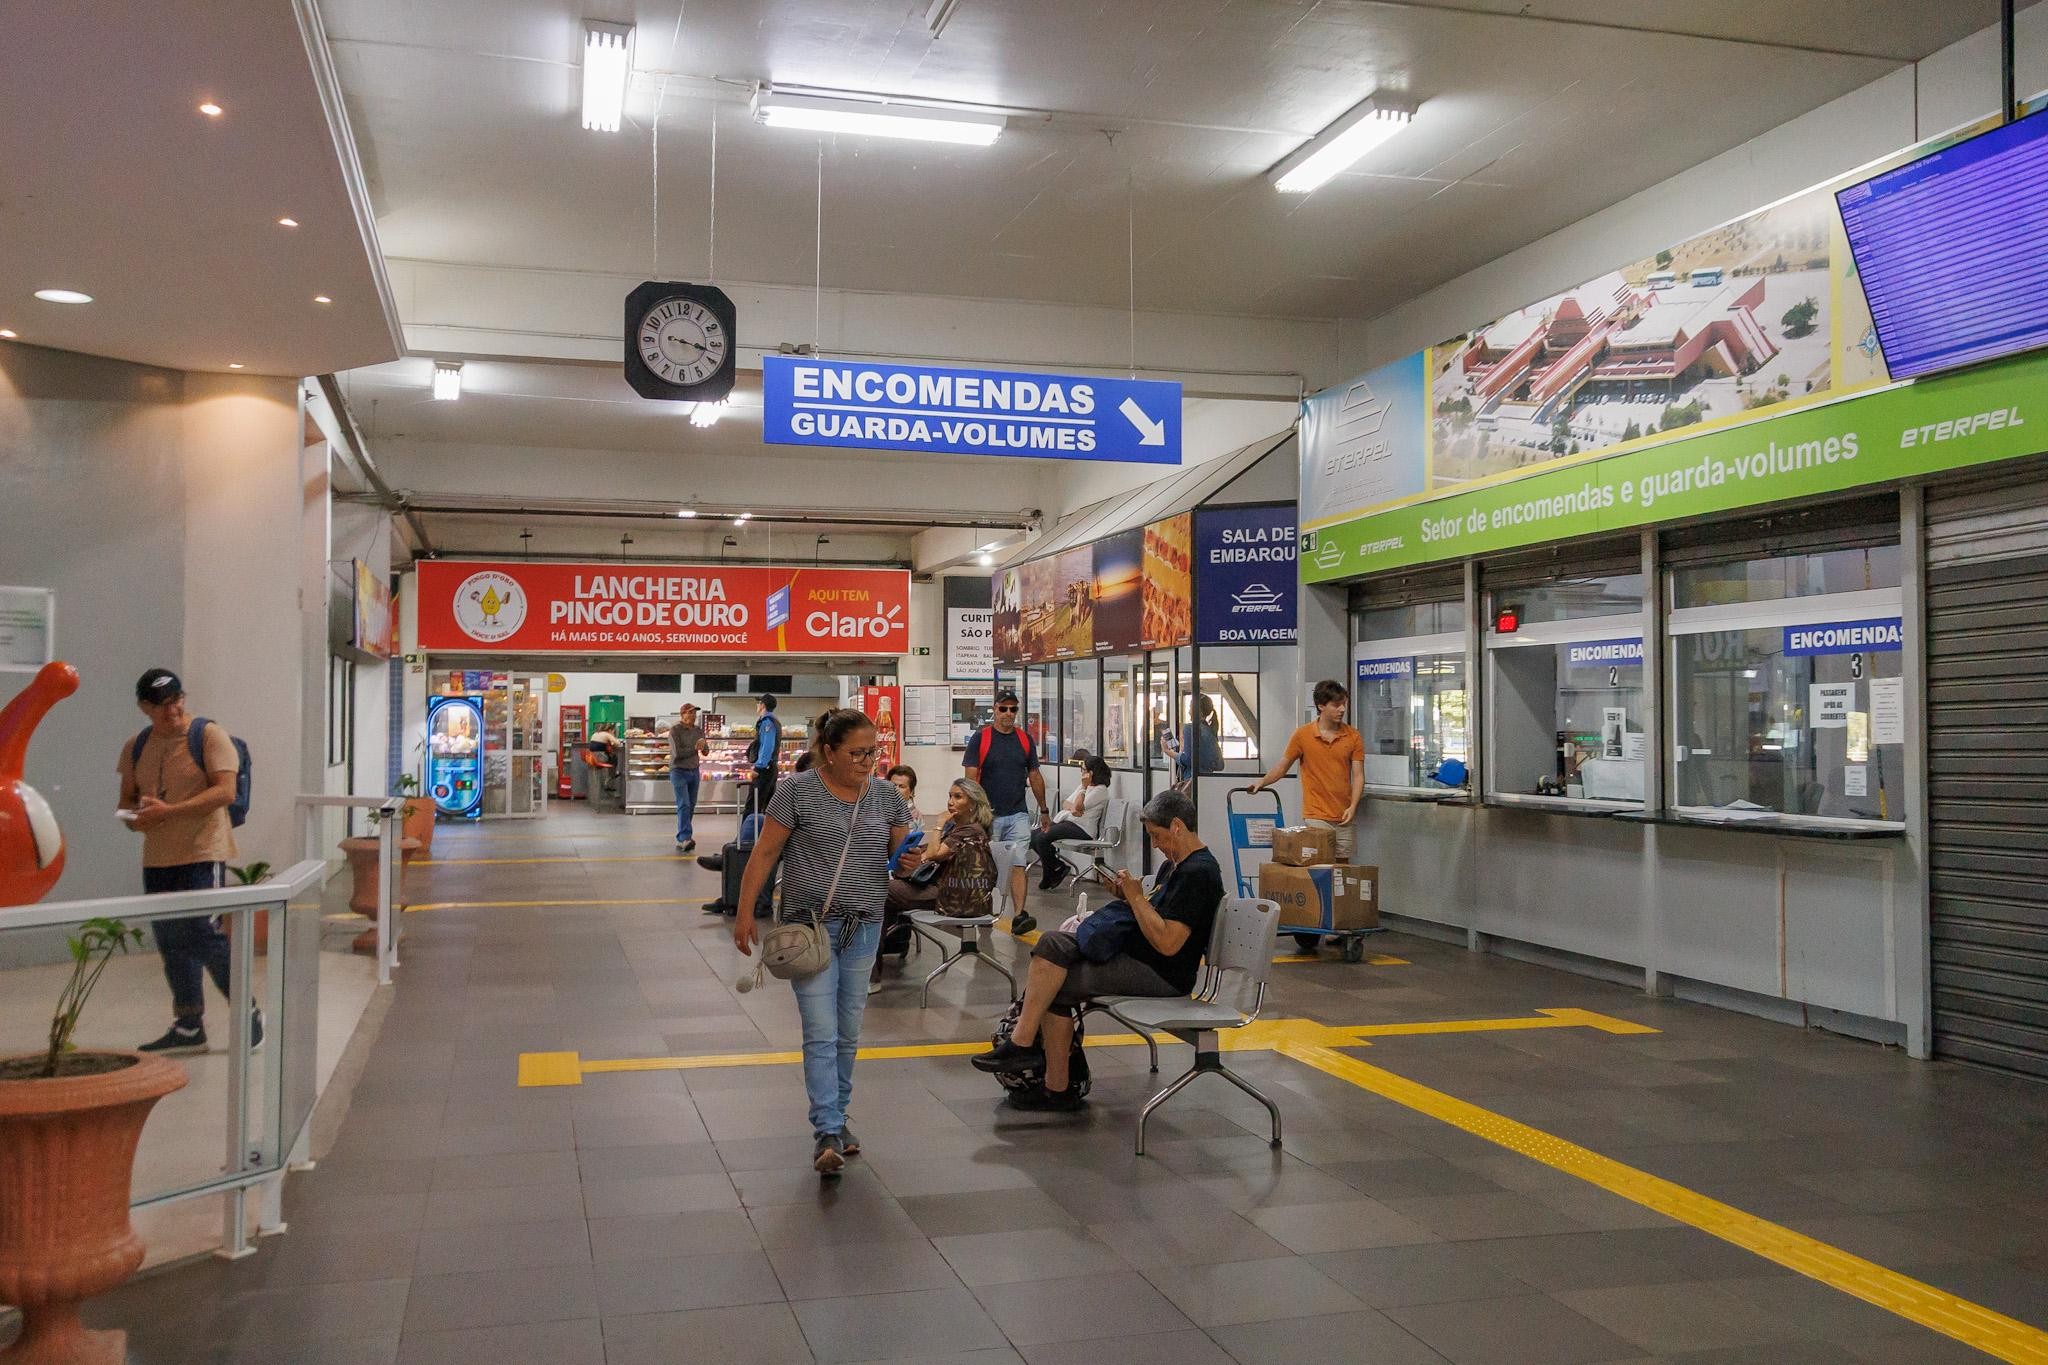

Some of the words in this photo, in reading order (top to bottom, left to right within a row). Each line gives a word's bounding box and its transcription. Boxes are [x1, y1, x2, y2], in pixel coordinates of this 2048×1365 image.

[660, 305, 673, 319] 11
[677, 303, 690, 316] 12
[696, 309, 704, 320] 1
[646, 316, 661, 331] 10
[706, 323, 718, 332] 2
[647, 352, 659, 361] 8
[706, 355, 717, 366] 4
[661, 364, 670, 375] 7
[679, 368, 685, 382] 6
[694, 366, 703, 378] 5
[793, 366, 1095, 414] ENCOMENDAS
[791, 412, 1097, 452] GUARDA-VOLUMES
[1421, 513, 1462, 543] Setor
[1467, 508, 1487, 534] de
[1491, 483, 1614, 529] encomendas
[1621, 482, 1633, 503] e
[1640, 432, 1859, 507] guarda-volumes
[1222, 527, 1268, 543] SALA
[1272, 527, 1295, 541] DE
[1210, 546, 1296, 563] EMBARQU
[574, 575, 726, 601] LANCHERIA
[808, 589, 839, 604] AQUI
[841, 589, 870, 601] TEM
[550, 600, 633, 626] PINGO
[636, 602, 671, 625] DE
[673, 603, 749, 627] OURO
[805, 611, 890, 638] Claro
[961, 626, 983, 638] SÃO
[985, 629, 993, 638] P
[551, 629, 566, 641] HÁ
[569, 631, 597, 642] MAIS
[600, 632, 614, 642] DE
[616, 632, 630, 642] 40
[632, 632, 664, 644] ANOS,
[666, 633, 720, 643] SERVINDO
[721, 631, 748, 643] VOCÊ
[1219, 629, 1247, 641] BOA
[1249, 628, 1298, 640] VIAGEM
[1359, 661, 1411, 676] ENCOMENDAS
[1852, 653, 1862, 679] 3
[1609, 666, 1617, 686] 2
